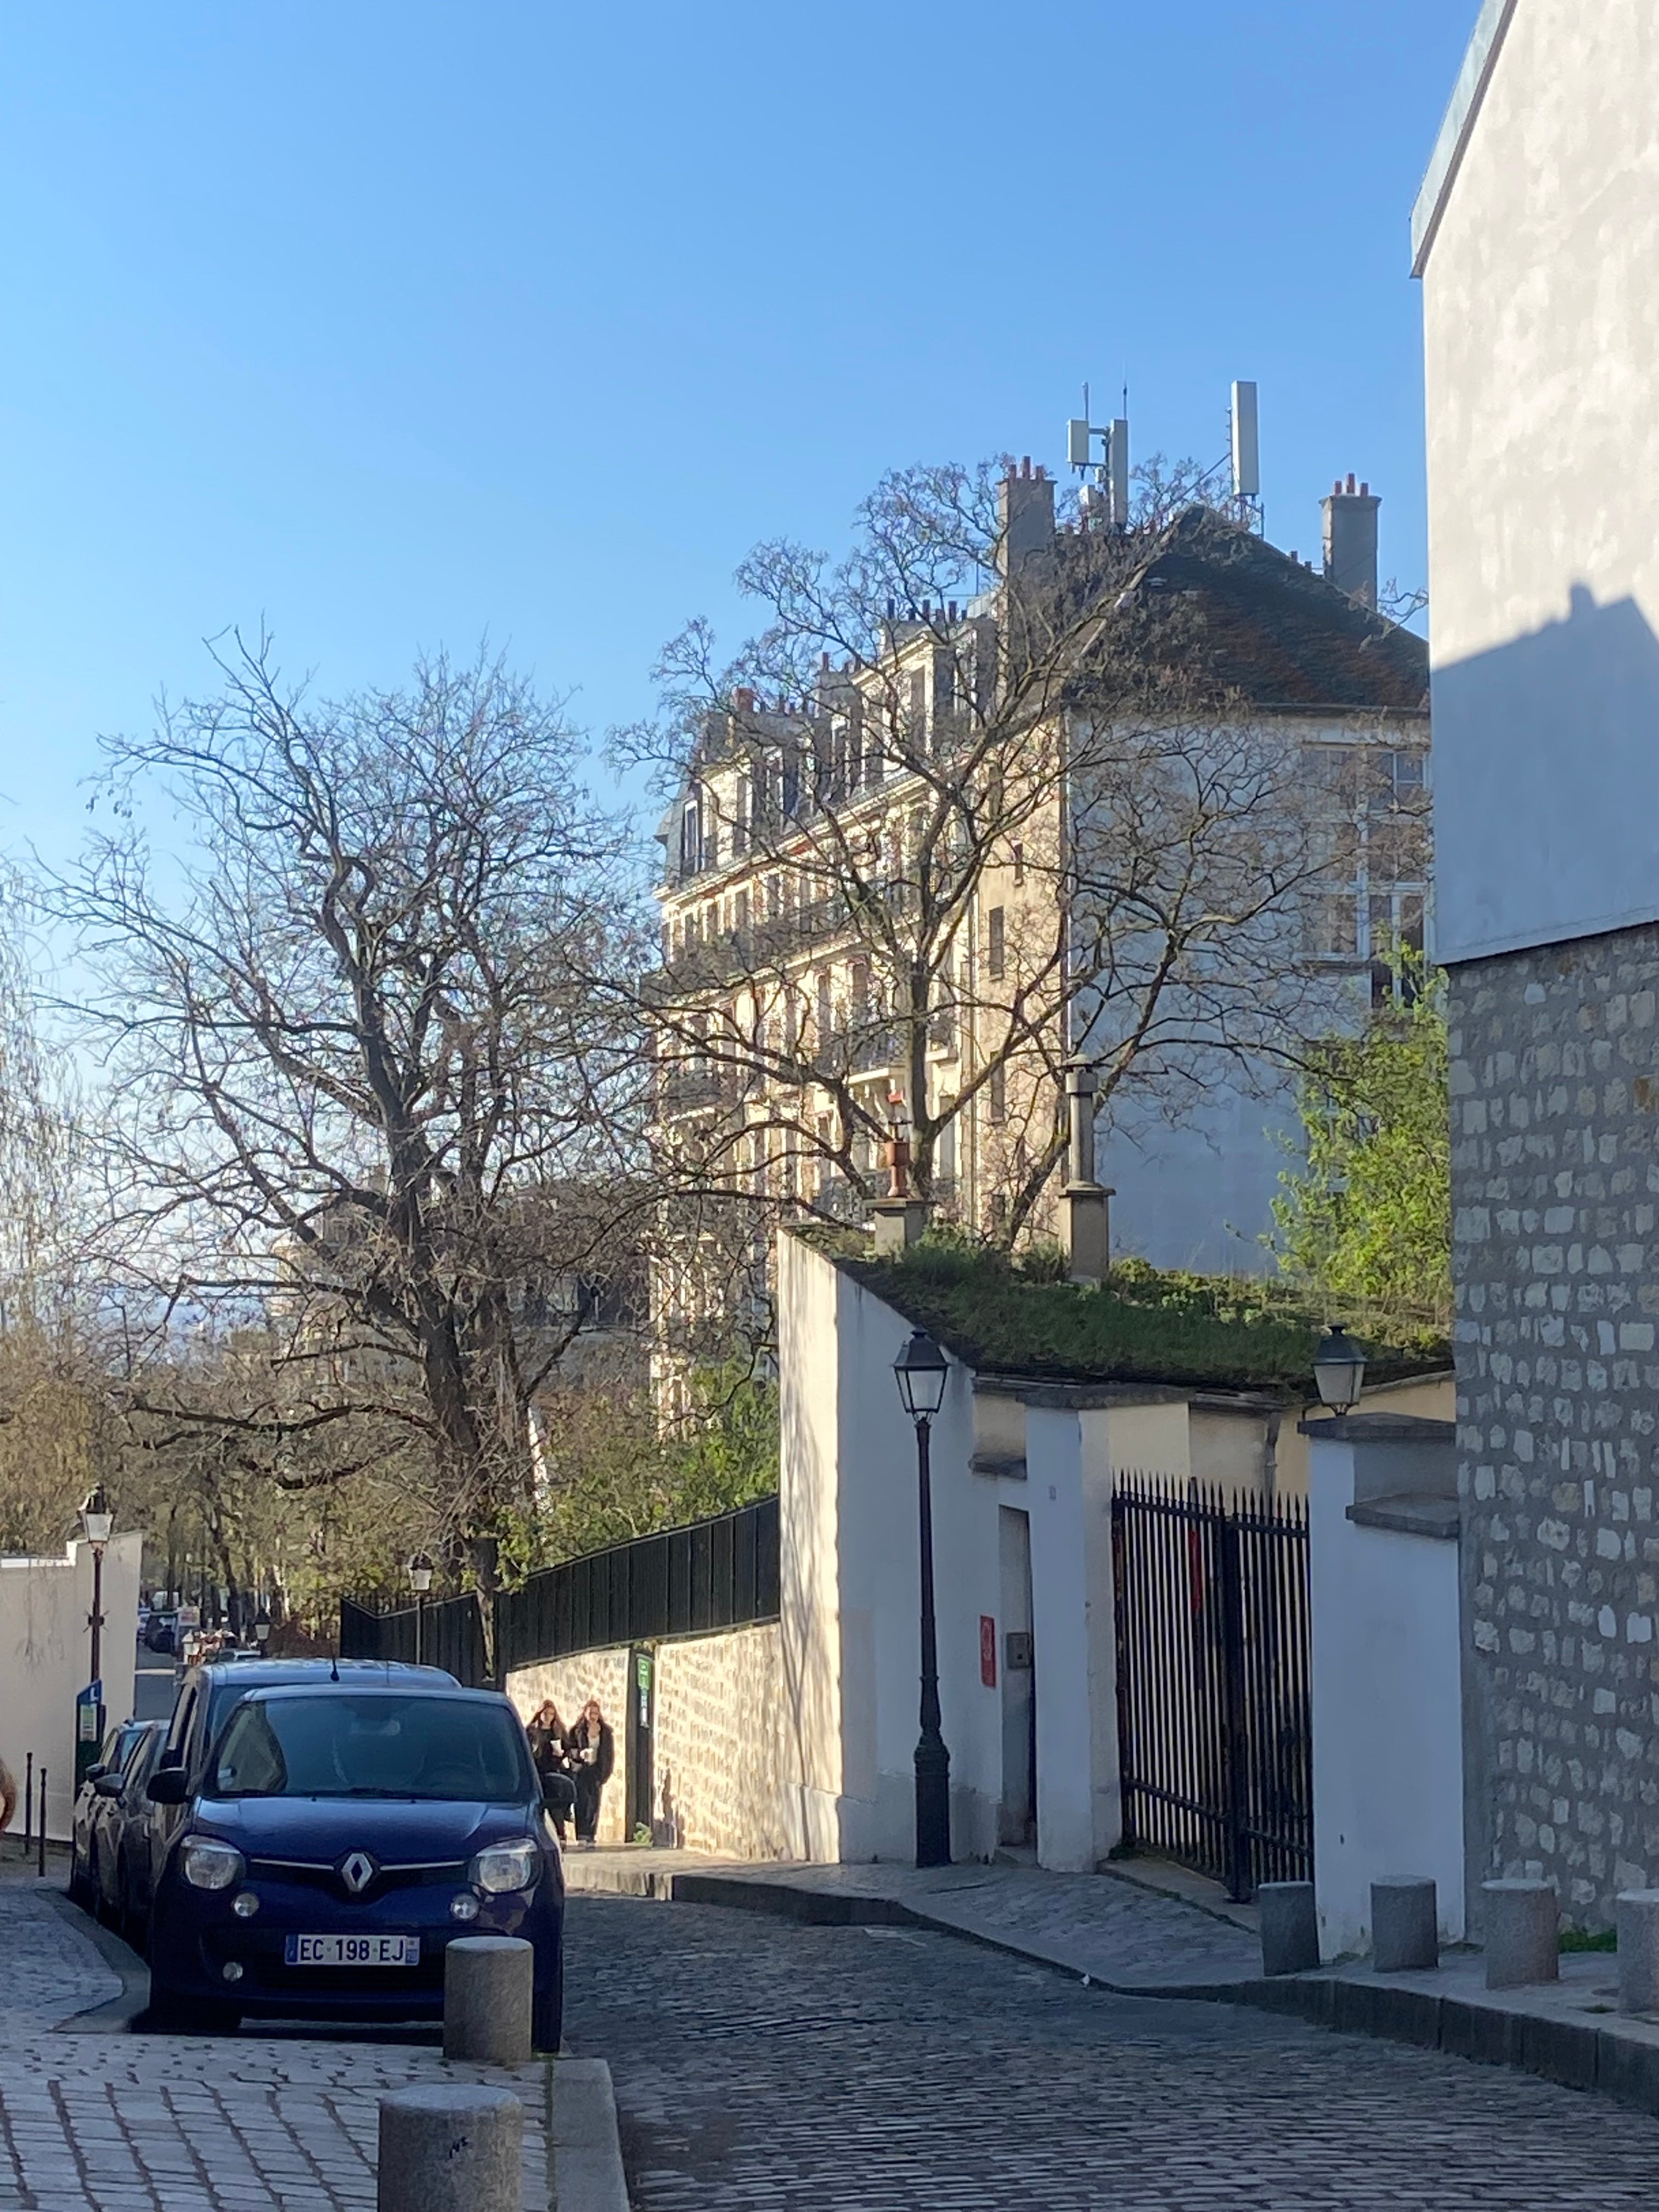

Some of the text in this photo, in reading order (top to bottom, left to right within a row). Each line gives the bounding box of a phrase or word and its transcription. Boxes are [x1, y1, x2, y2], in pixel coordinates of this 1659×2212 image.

[301, 1939, 324, 1960] EC
[336, 1939, 370, 1960] 198
[379, 1939, 404, 1961] EJ
